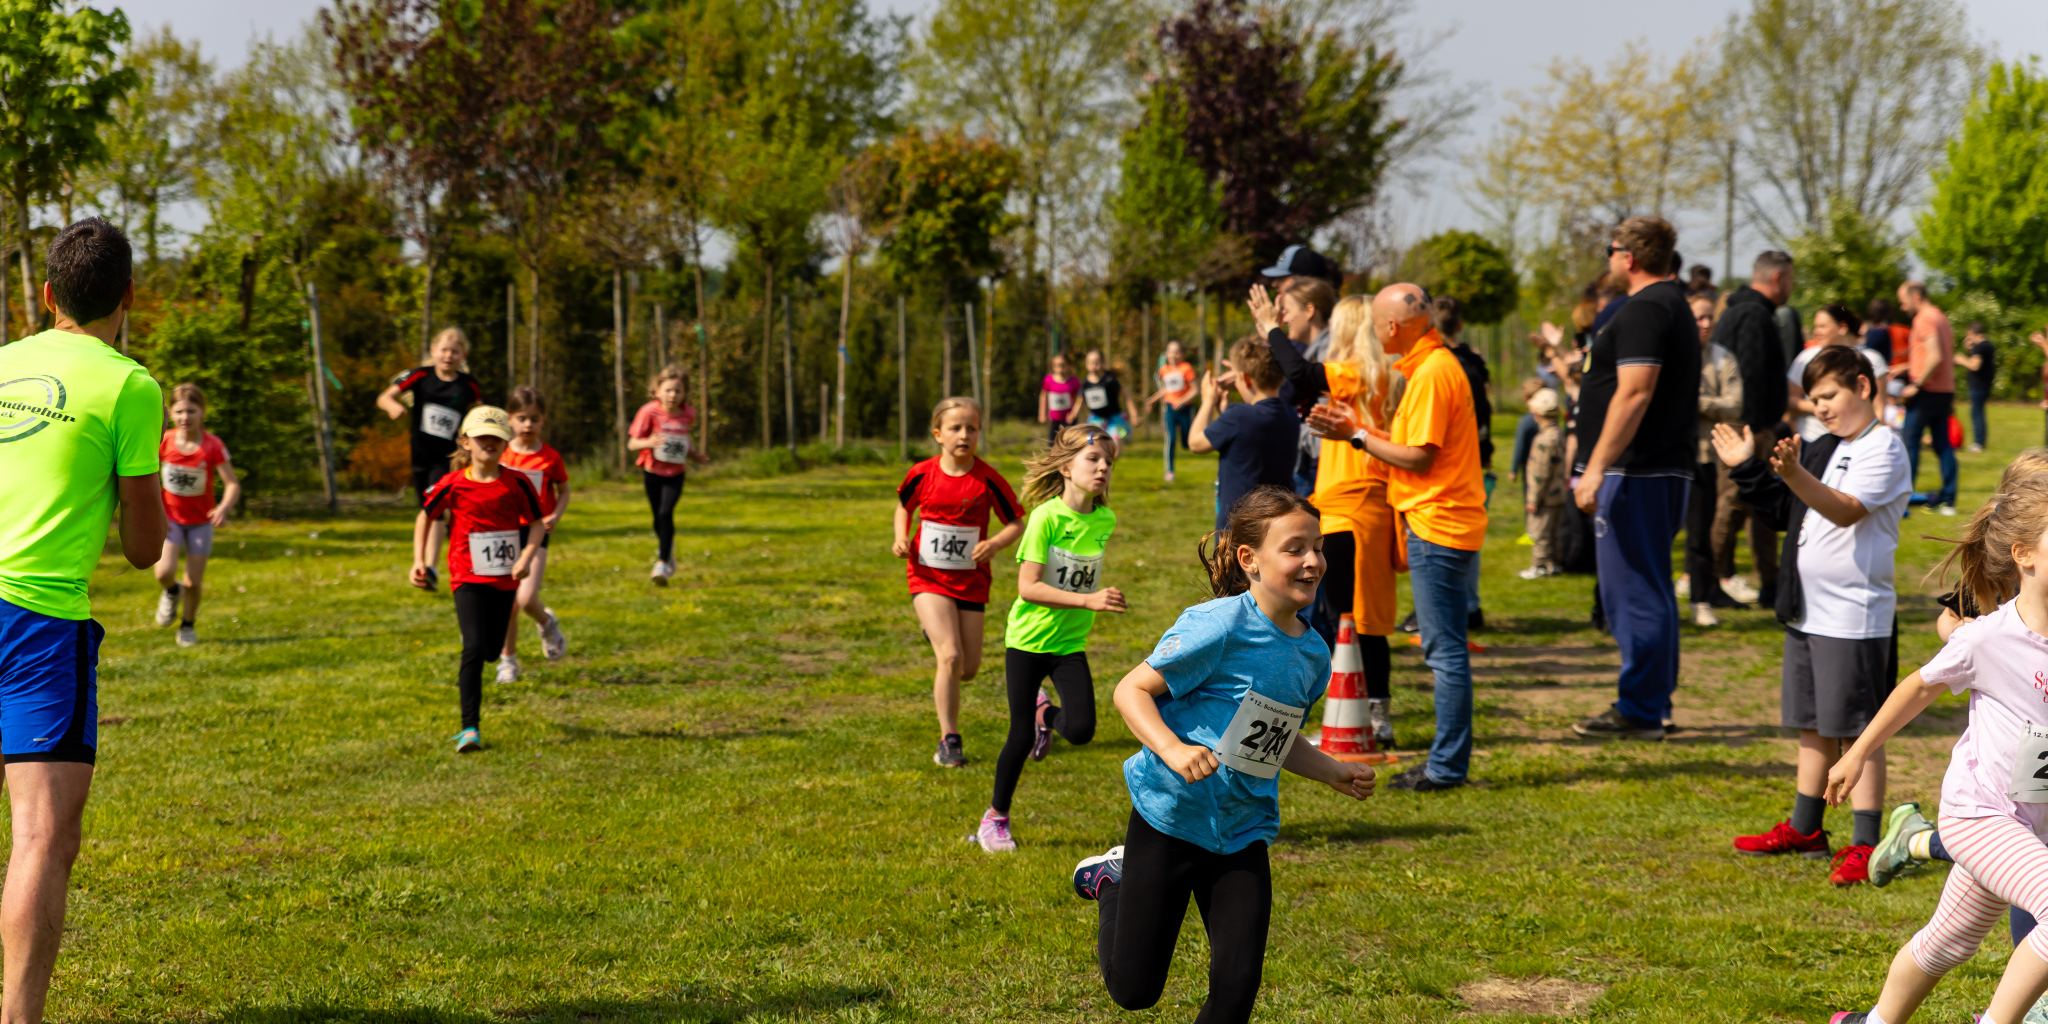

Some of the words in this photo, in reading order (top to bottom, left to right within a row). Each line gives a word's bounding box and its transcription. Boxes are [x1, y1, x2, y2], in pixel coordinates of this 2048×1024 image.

[0, 400, 75, 423] ndreher
[482, 543, 515, 562] 140
[931, 537, 968, 555] 147
[1056, 566, 1096, 588] 104
[1240, 720, 1292, 756] 271
